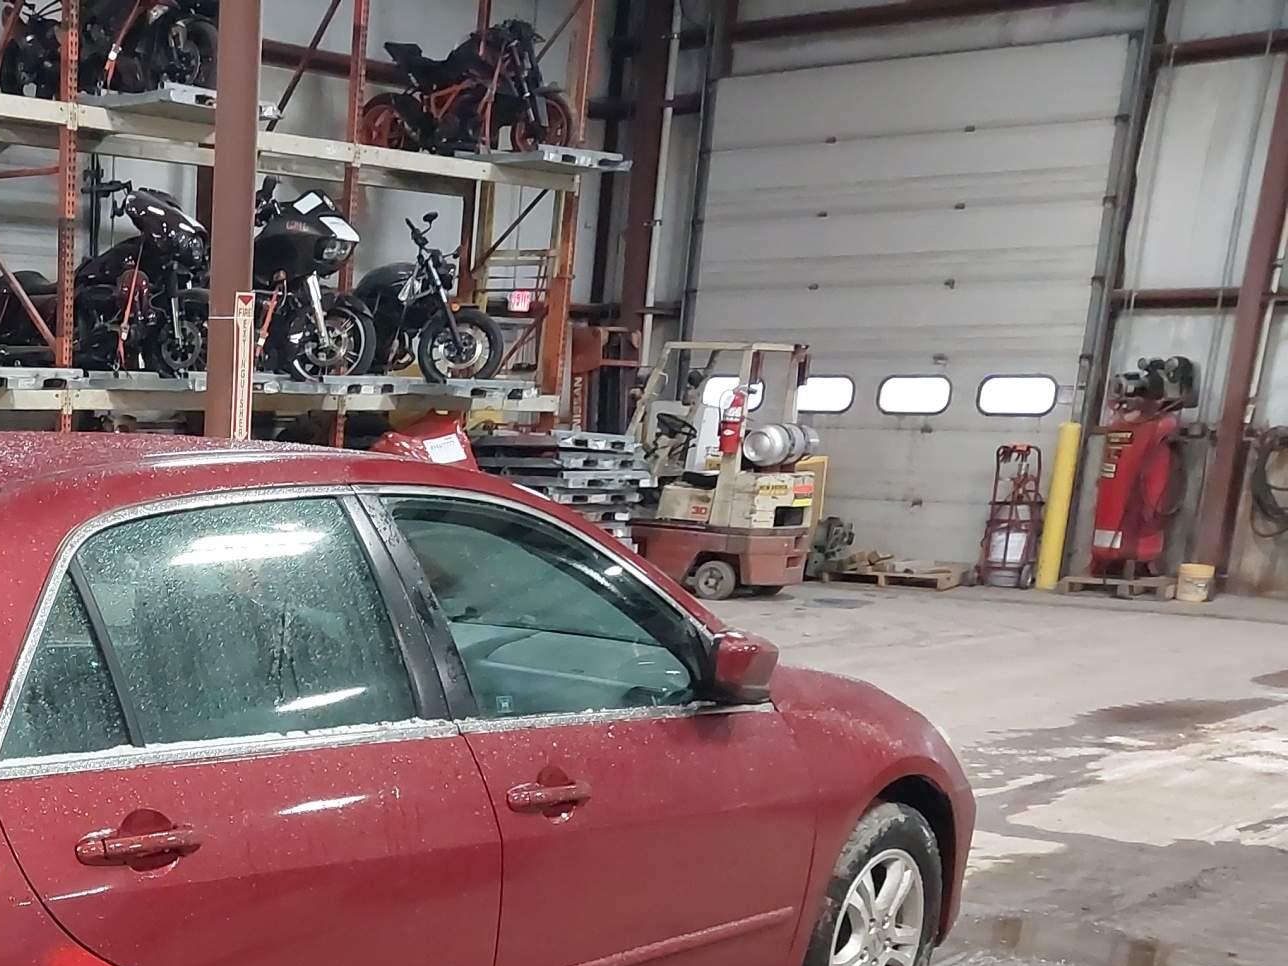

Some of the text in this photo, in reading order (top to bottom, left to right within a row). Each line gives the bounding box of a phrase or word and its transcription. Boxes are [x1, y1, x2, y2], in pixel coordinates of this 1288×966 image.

[238, 307, 253, 318] FIRE
[237, 319, 248, 437] EXTINGUISHER
[572, 376, 583, 431] NISSAN
